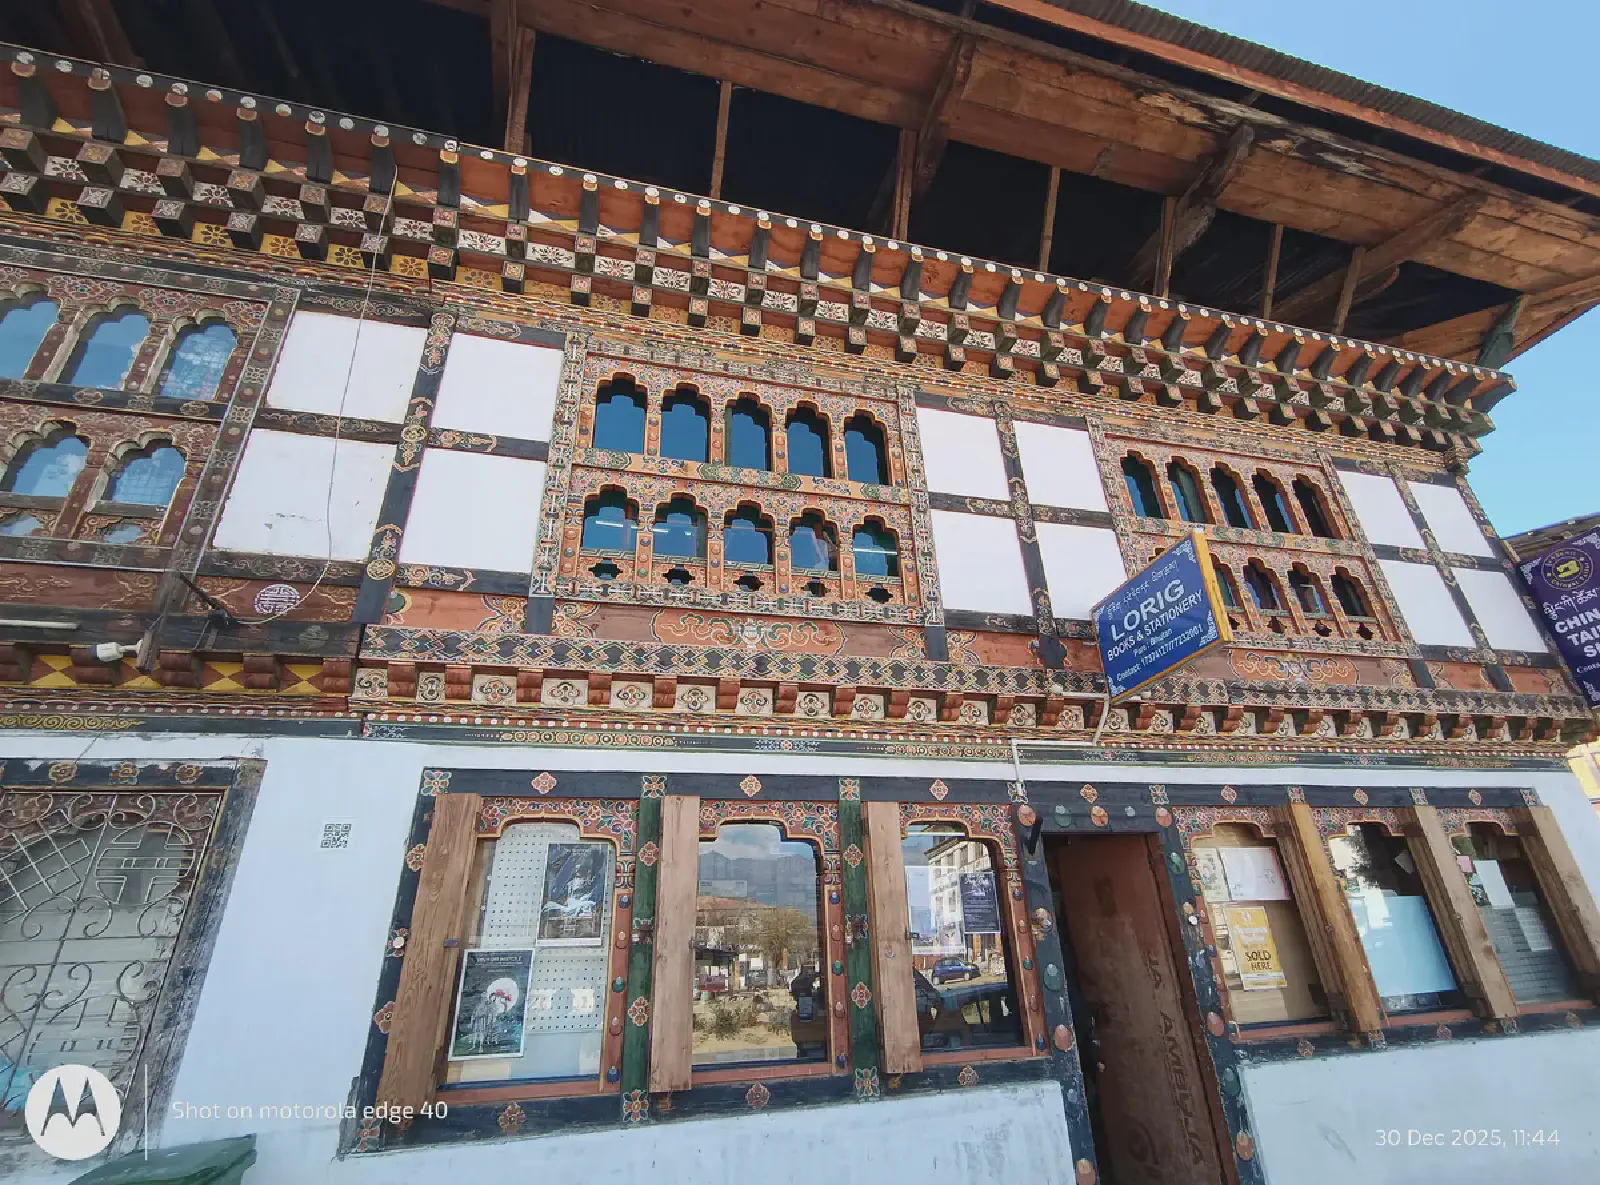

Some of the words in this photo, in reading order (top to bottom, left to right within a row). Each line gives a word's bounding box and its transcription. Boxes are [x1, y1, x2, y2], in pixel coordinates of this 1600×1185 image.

[1107, 633, 1136, 661] BOOKS
[1136, 628, 1145, 642] &
[1143, 589, 1204, 637] STATIONERY
[1110, 579, 1185, 642] LORIG
[1245, 950, 1271, 961] SOLD
[1251, 961, 1272, 970] HERE
